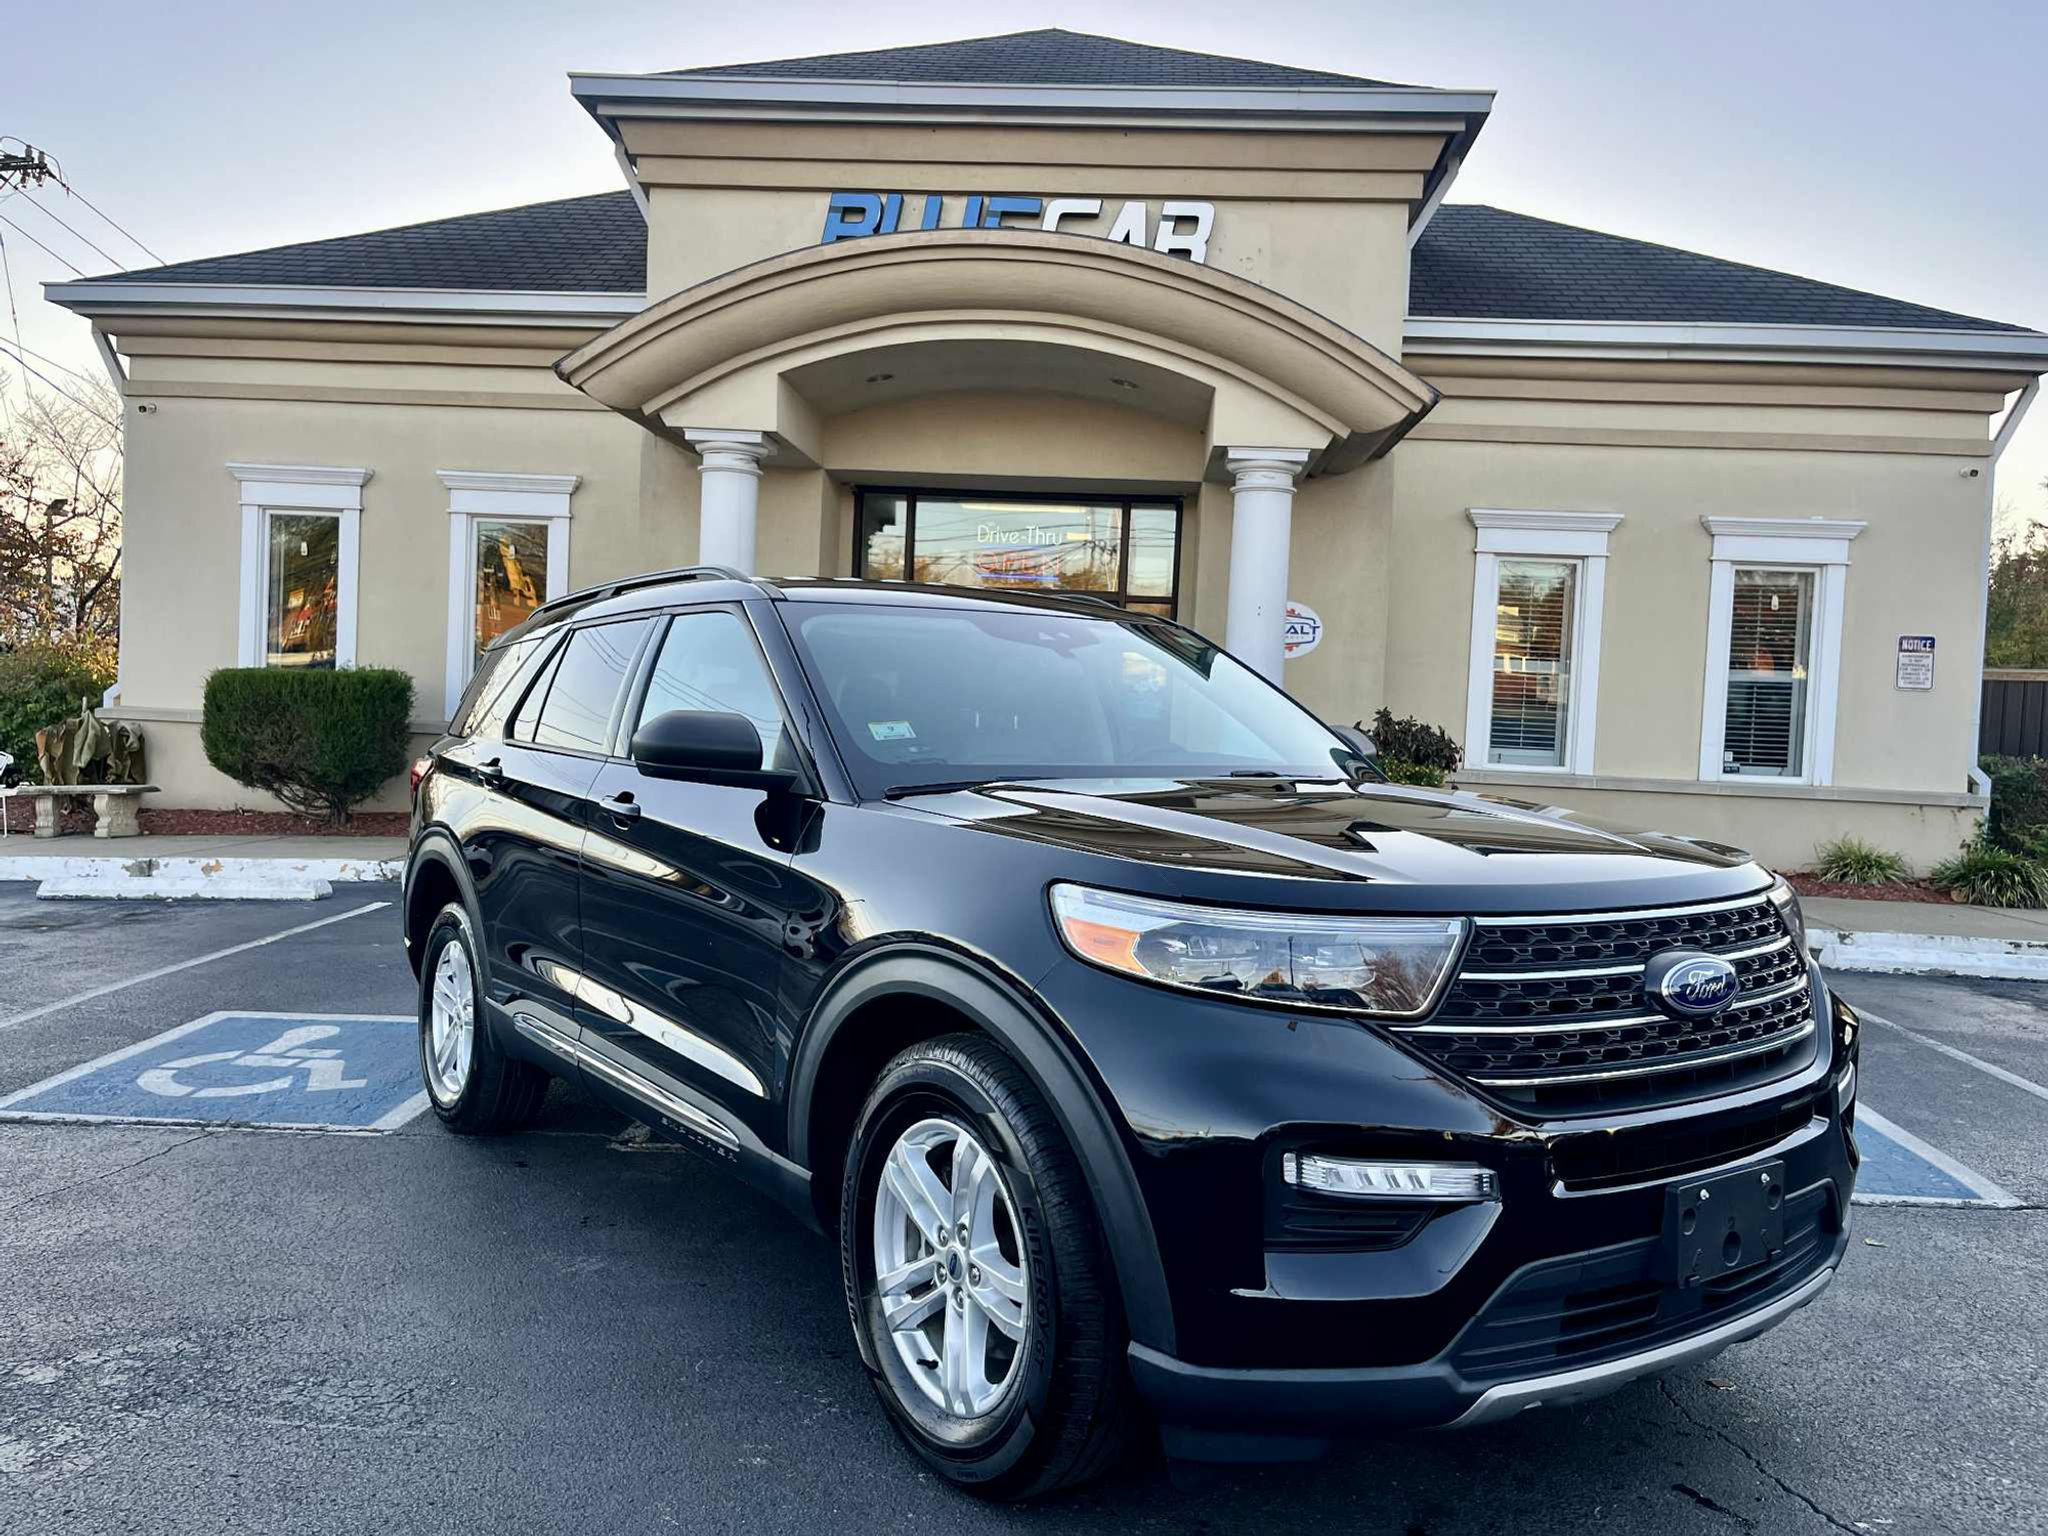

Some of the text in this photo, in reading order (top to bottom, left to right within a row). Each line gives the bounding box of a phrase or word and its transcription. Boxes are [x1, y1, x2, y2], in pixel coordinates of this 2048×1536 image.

[977, 525, 1063, 545] Drive-Thru
[1901, 639, 1932, 652] NOTICE
[1686, 969, 1728, 1002] Ford
